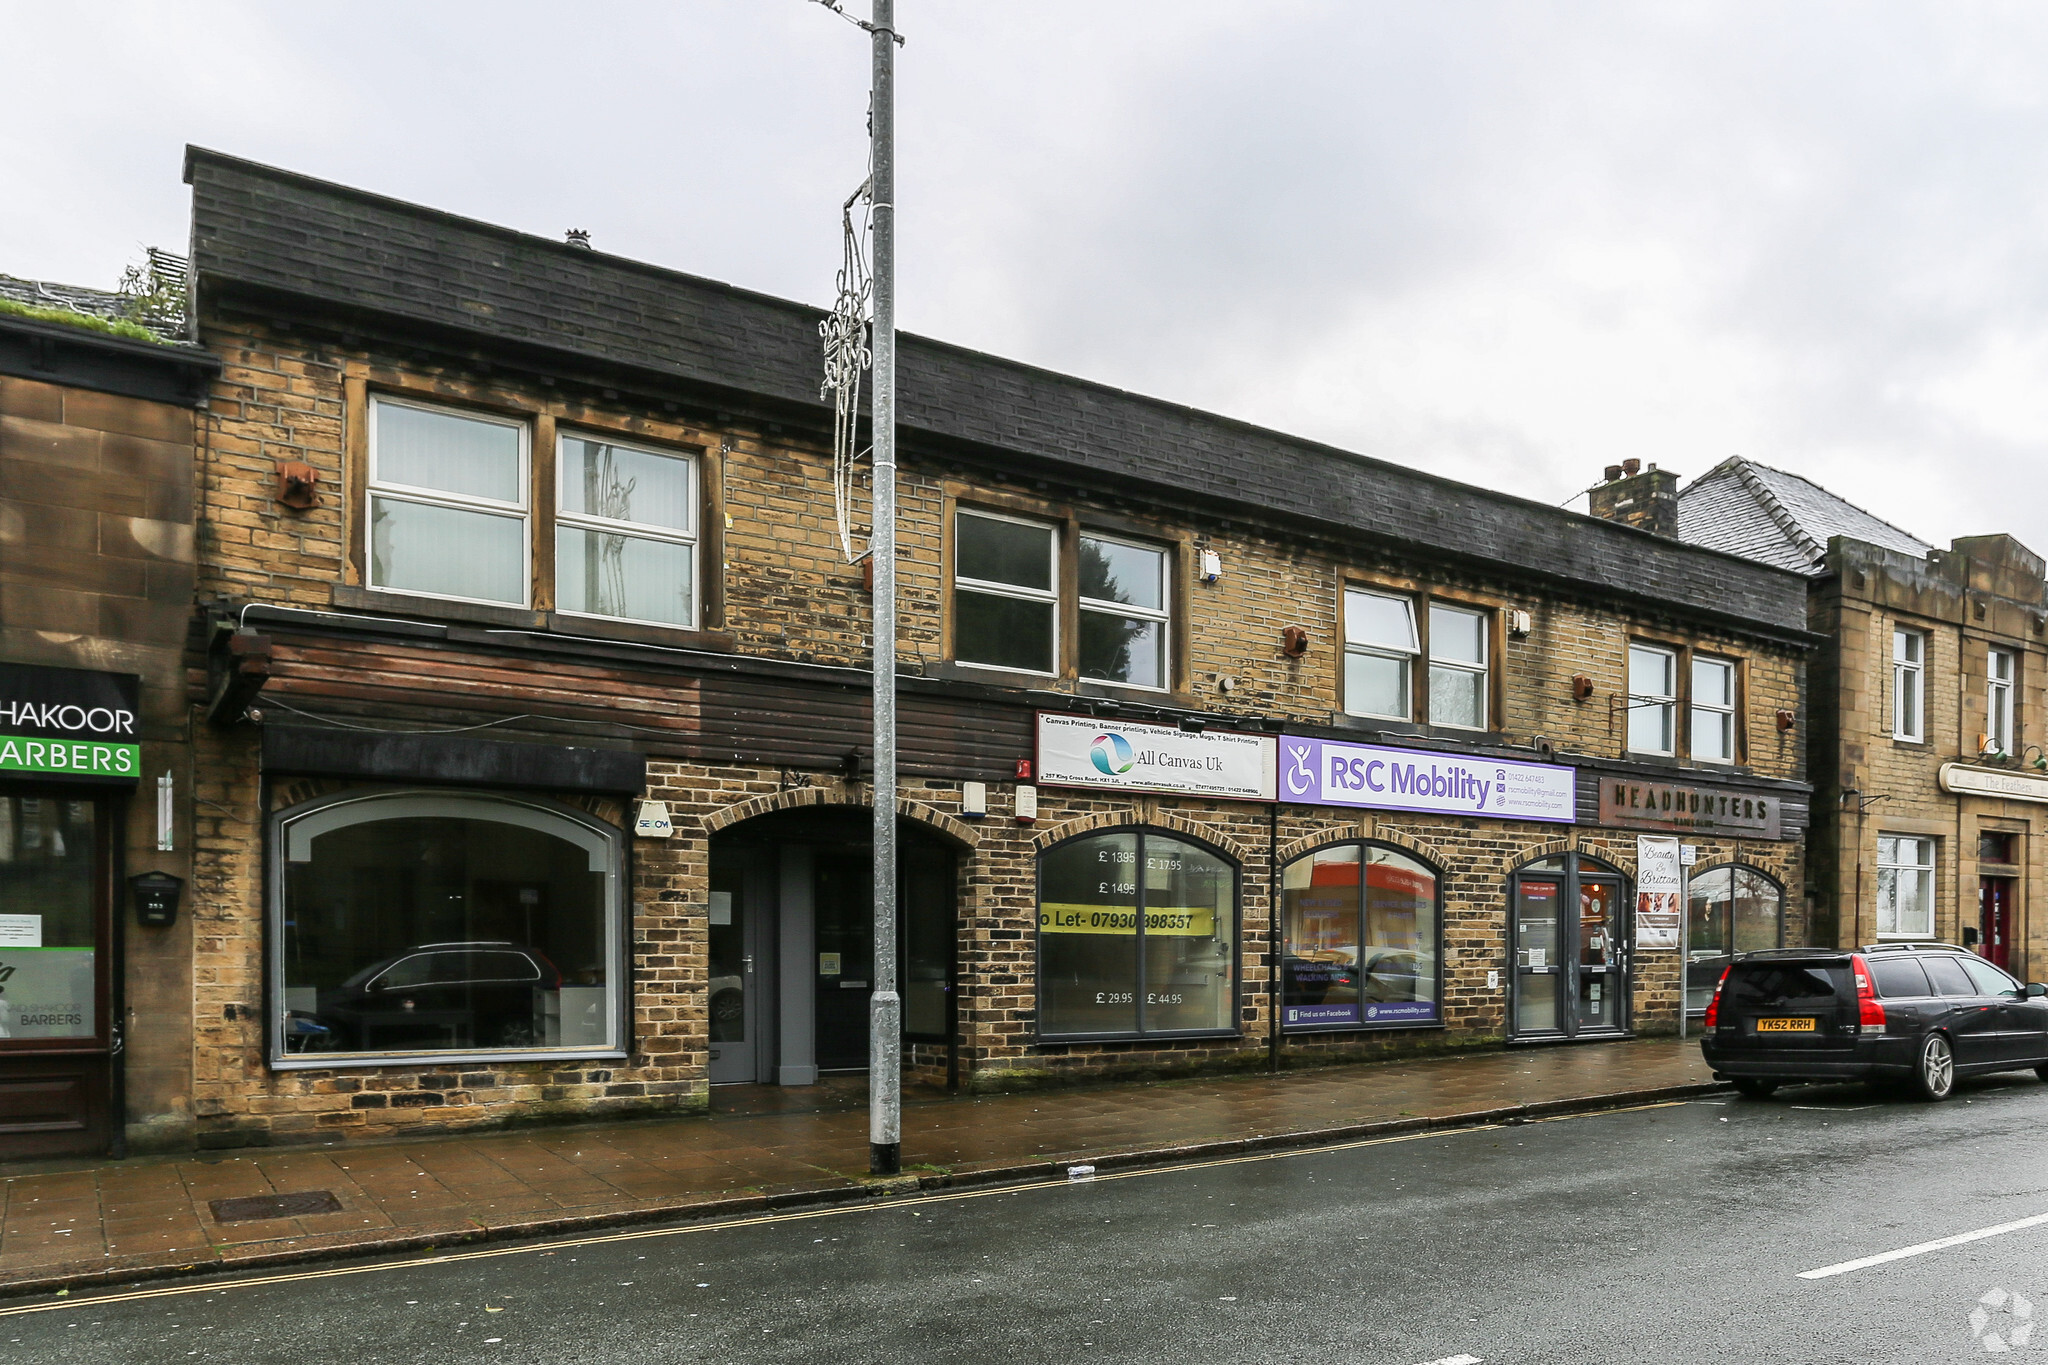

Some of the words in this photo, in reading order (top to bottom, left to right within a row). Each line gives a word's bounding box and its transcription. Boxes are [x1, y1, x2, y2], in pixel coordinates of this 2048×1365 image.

[1045, 717, 1070, 726] Canvas
[1071, 720, 1098, 730] Printing,
[1099, 723, 1121, 731] Banner
[1149, 728, 1171, 736] Vehicle
[1173, 731, 1199, 740] Signage,
[1237, 738, 1259, 747] Printing
[1137, 750, 1155, 766] All
[1158, 752, 1203, 769] Canvas
[1206, 756, 1223, 771] Uk
[1331, 756, 1386, 793] RSC
[1391, 762, 1491, 809] Mobility
[1508, 772, 1524, 782] 01422
[1525, 774, 1545, 784] 647483
[1985, 776, 1999, 789] The
[2001, 777, 2033, 793] Feathers
[1508, 786, 1567, 798] rscmobility@gmail.com
[1508, 799, 1563, 810] www.rscmobility.com
[1615, 784, 1767, 820] HEADHUNTERS
[639, 819, 669, 829] SECOM
[1098, 851, 1108, 862] £
[1644, 844, 1675, 863] Beauty
[1147, 858, 1156, 869] £
[1159, 860, 1182, 870] 17.95
[1640, 869, 1679, 885] Brittani
[1098, 882, 1108, 893] £
[1040, 915, 1050, 926] o
[1096, 992, 1105, 1004] £
[1108, 993, 1133, 1004] 29.95
[1147, 993, 1156, 1004] £
[1158, 994, 1182, 1004] 44.95
[1379, 1007, 1430, 1015] www.rscmobility.com
[21, 1014, 82, 1026] BARBERS
[1761, 1019, 1788, 1030] YK52
[1790, 1019, 1811, 1030] RRH
